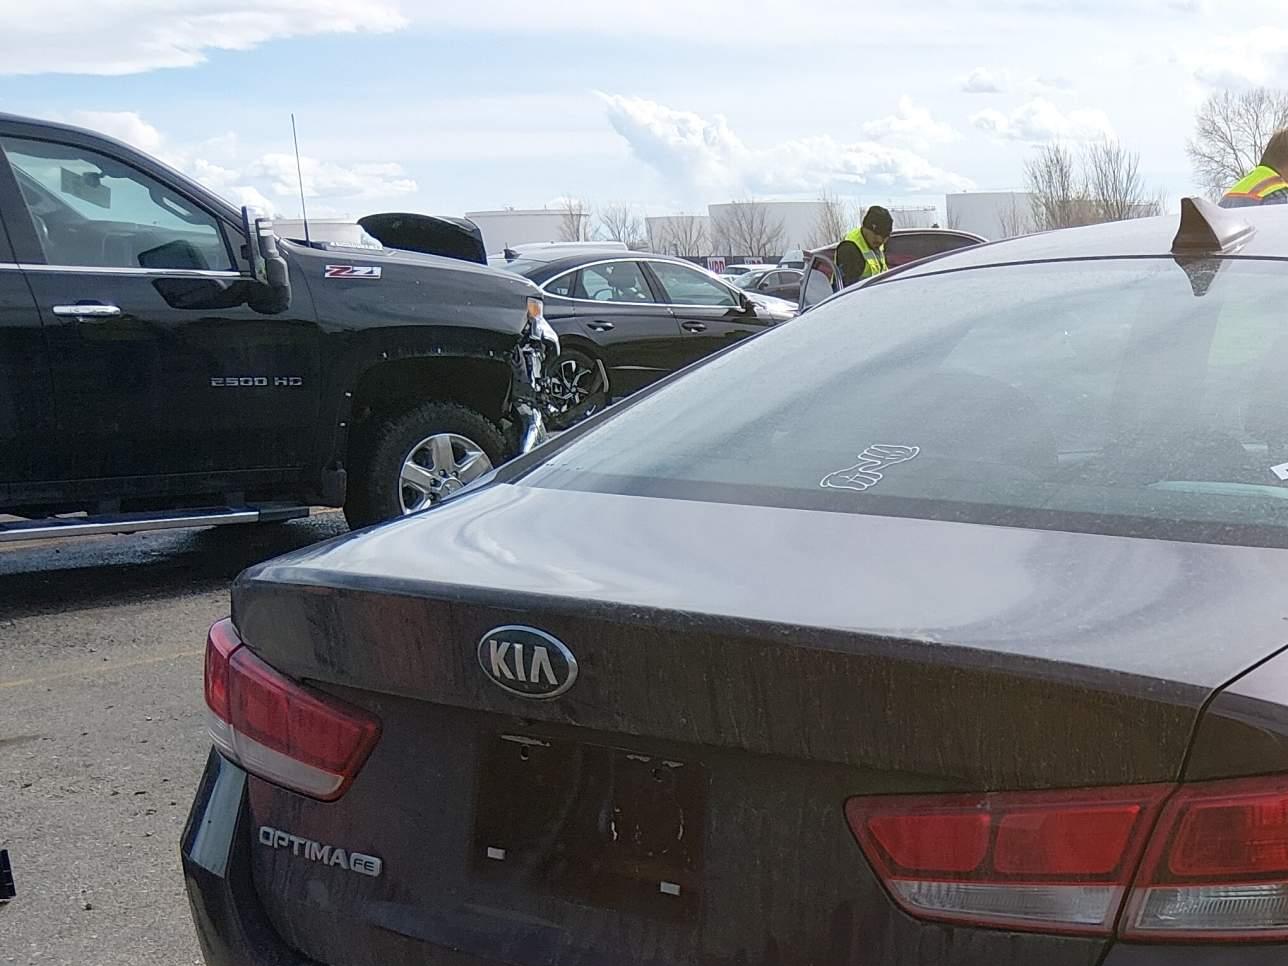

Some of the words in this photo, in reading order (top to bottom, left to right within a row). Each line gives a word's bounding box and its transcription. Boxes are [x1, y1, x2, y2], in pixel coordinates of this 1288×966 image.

[325, 265, 381, 279] Z71
[211, 377, 268, 386] 2500
[274, 377, 302, 386] HD
[489, 639, 559, 685] KIA
[260, 826, 350, 870] OPTIMA
